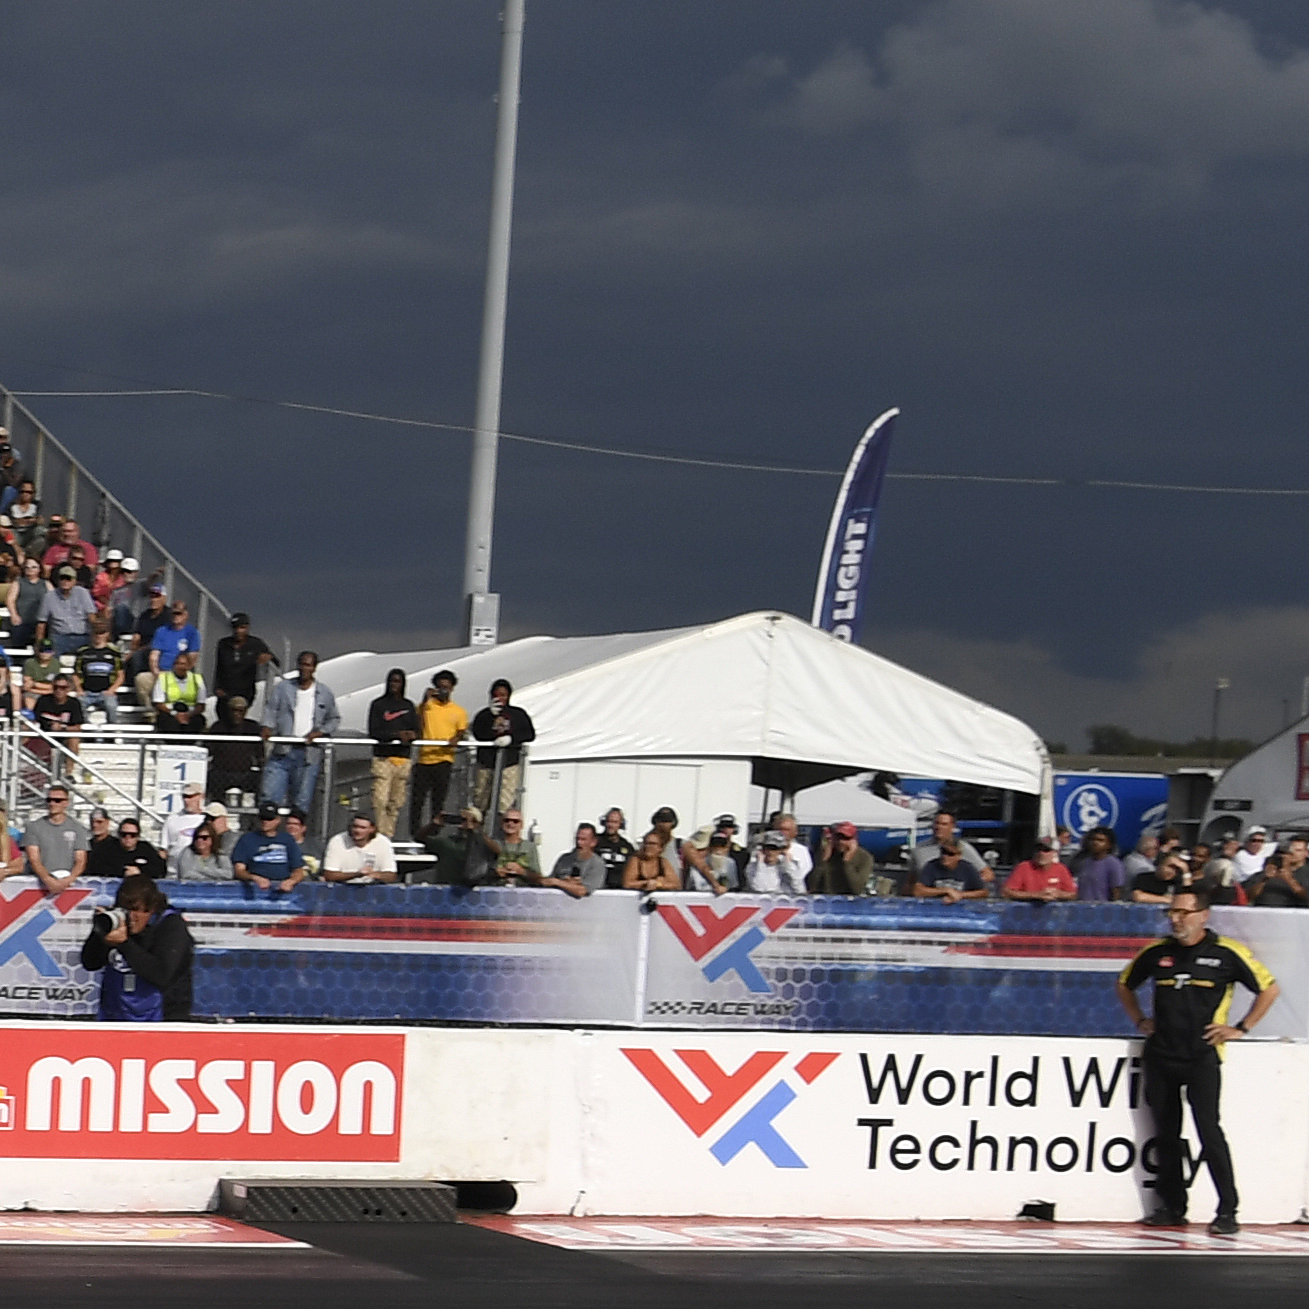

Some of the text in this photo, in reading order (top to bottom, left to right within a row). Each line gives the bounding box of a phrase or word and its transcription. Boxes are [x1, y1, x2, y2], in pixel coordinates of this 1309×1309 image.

[832, 517, 868, 621] LIGHT
[174, 762, 186, 781] 1
[688, 1000, 795, 1017] RACEWAY
[26, 1056, 396, 1136] MISSION
[859, 1053, 1141, 1109] World Wi
